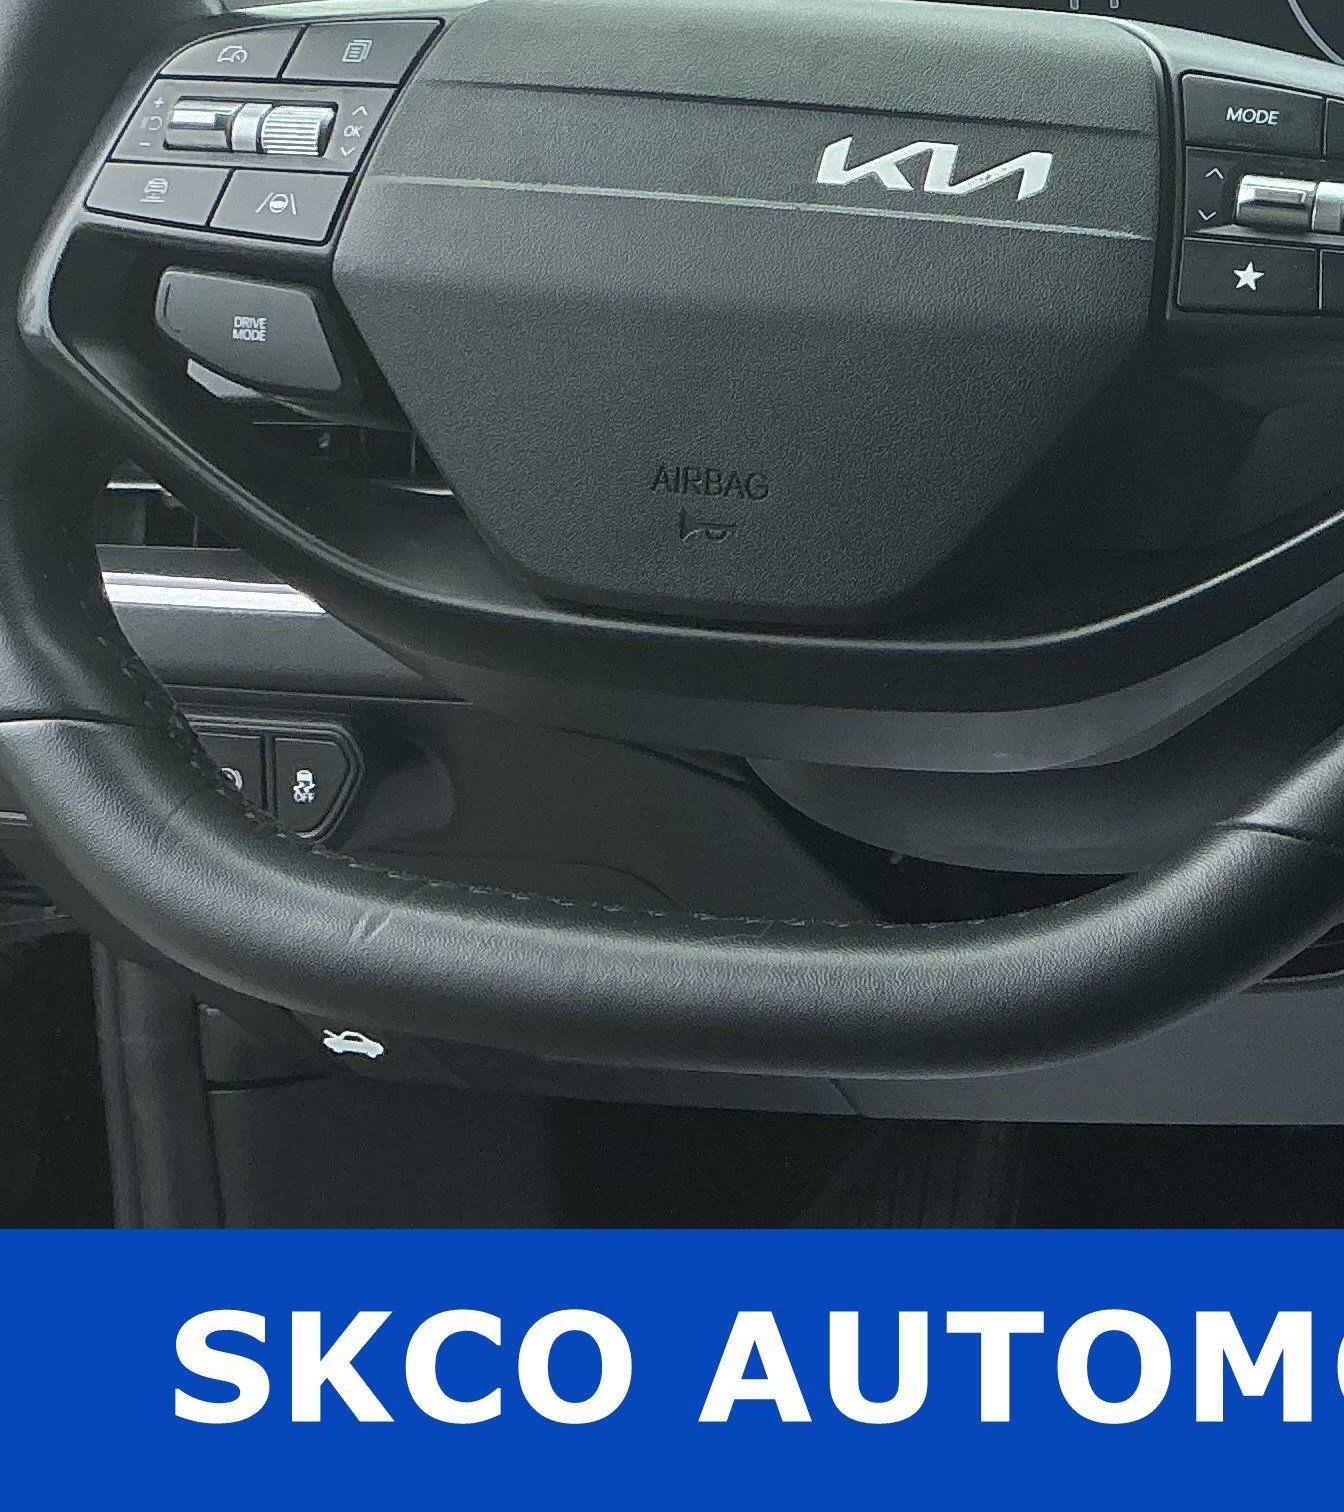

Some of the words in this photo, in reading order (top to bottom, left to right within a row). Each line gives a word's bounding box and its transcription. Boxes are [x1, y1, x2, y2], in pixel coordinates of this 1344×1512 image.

[1227, 108, 1279, 124] MODE
[816, 137, 1052, 200] KIA
[233, 316, 268, 329] DRIVE
[232, 328, 268, 342] MODE
[650, 461, 771, 502] AIRBAG
[293, 792, 314, 803] OFF
